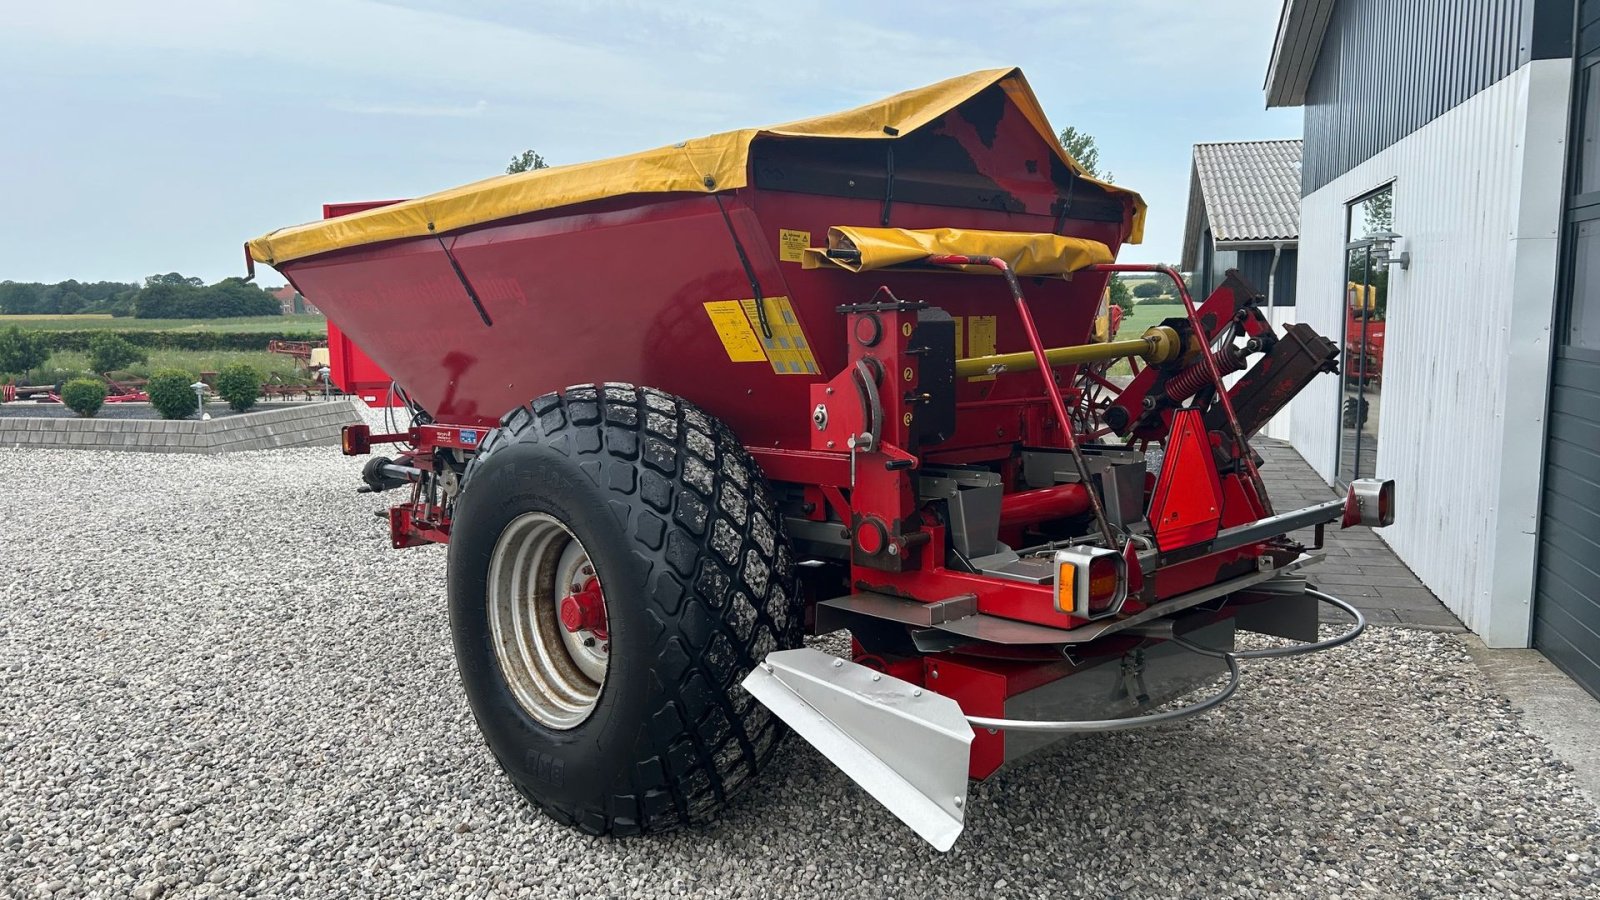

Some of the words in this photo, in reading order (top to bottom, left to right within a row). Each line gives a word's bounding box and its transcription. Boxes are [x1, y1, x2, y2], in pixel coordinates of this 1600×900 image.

[905, 324, 909, 334] 1
[906, 369, 912, 380] 2
[905, 414, 912, 425] 3
